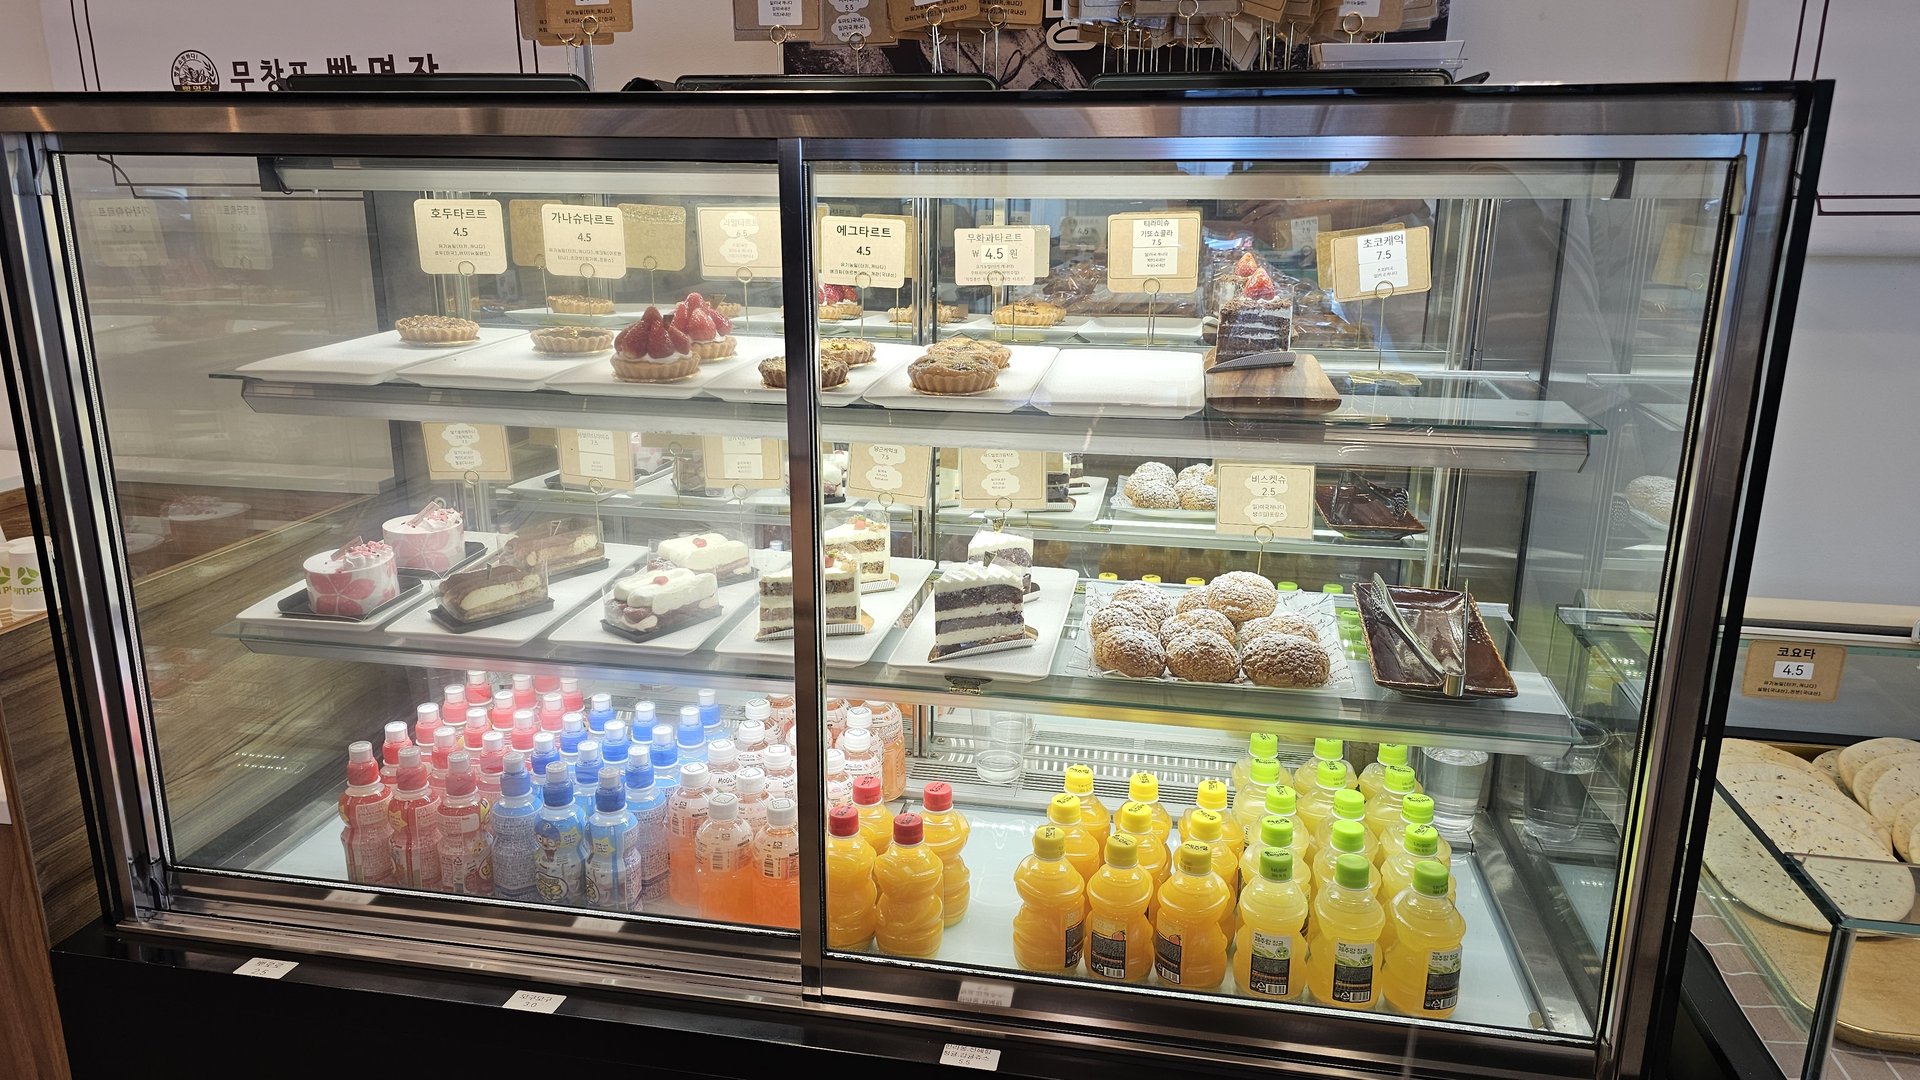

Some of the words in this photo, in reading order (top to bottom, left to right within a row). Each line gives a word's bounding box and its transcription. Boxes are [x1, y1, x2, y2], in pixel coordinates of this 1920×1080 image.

[431, 208, 487, 219] 호두타르트
[551, 212, 615, 225] 가나슈타르트
[453, 227, 468, 237] 4.5
[836, 225, 892, 238] 에그타르트
[577, 233, 592, 242] 4.5
[967, 232, 1023, 243] 무화과타르트
[1363, 233, 1404, 249] 초코케익
[856, 246, 871, 256] 4.5
[985, 247, 1004, 260] 4.5
[1010, 249, 1018, 260] 원
[1376, 250, 1392, 260] 7.5
[1251, 475, 1286, 485] 비스켓슈
[1262, 487, 1276, 496] 2.5
[1777, 646, 1816, 659] 코요타
[1783, 664, 1804, 676] 4.5
